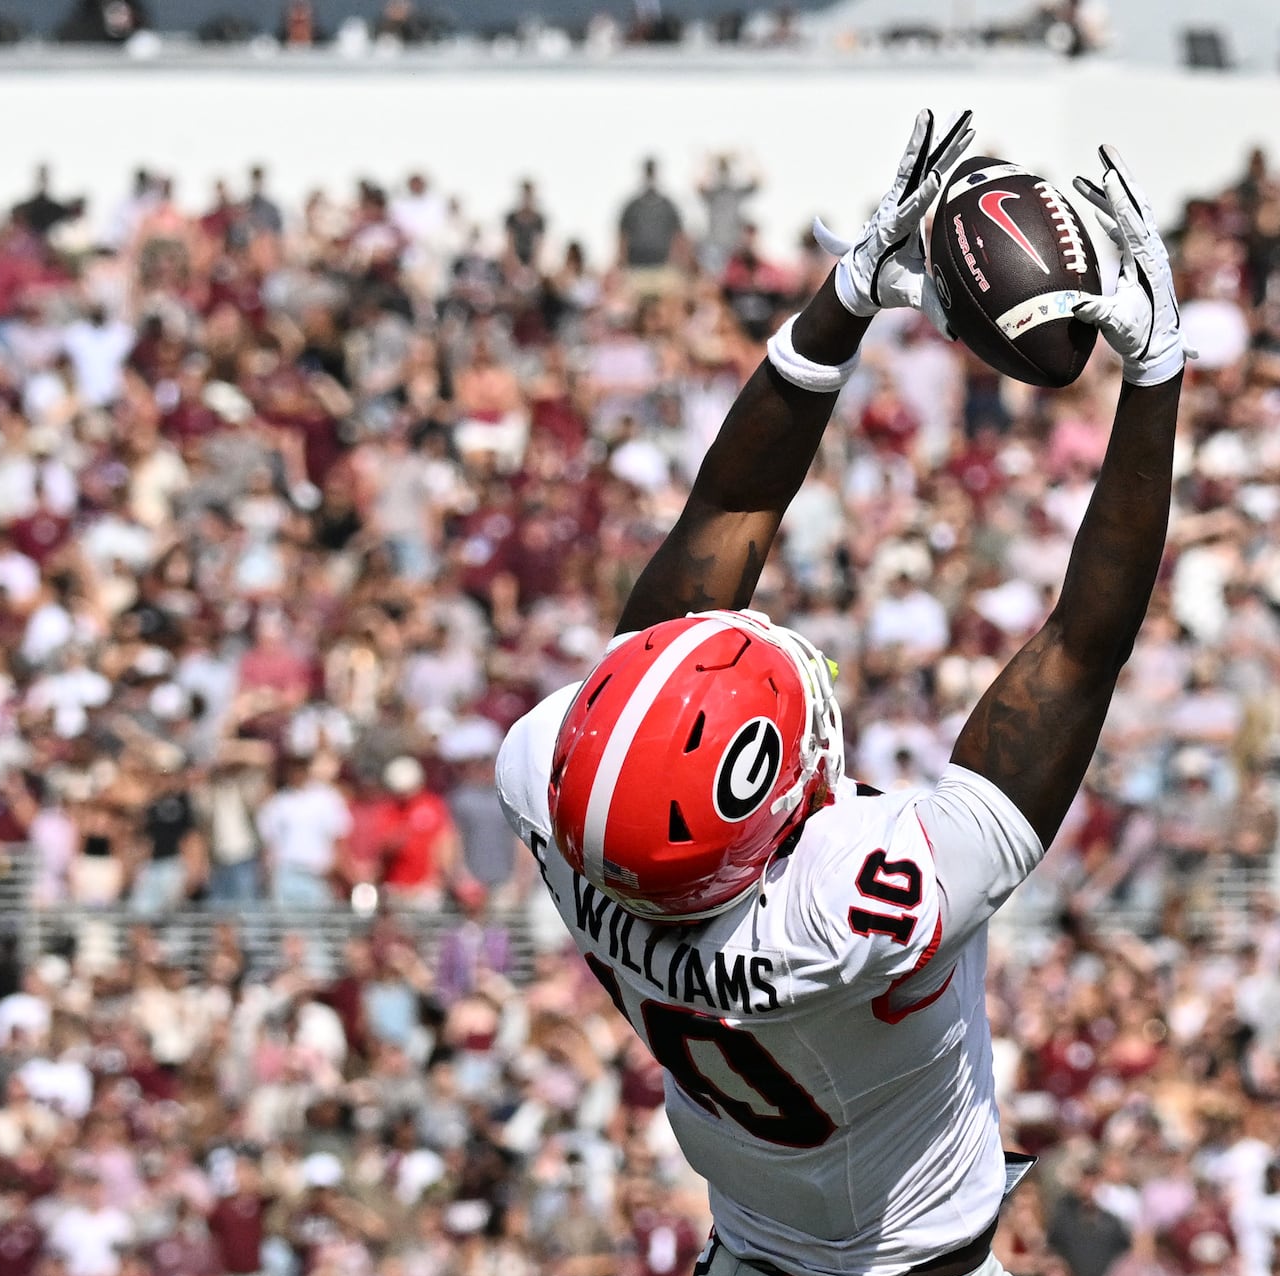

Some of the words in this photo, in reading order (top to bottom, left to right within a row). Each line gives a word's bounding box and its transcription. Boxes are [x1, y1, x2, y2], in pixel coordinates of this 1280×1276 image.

[953, 213, 970, 254] VAPOR
[965, 253, 990, 293] ELITE
[716, 718, 781, 820] G
[573, 872, 781, 1014] WILLIAMS
[848, 848, 922, 946] 10
